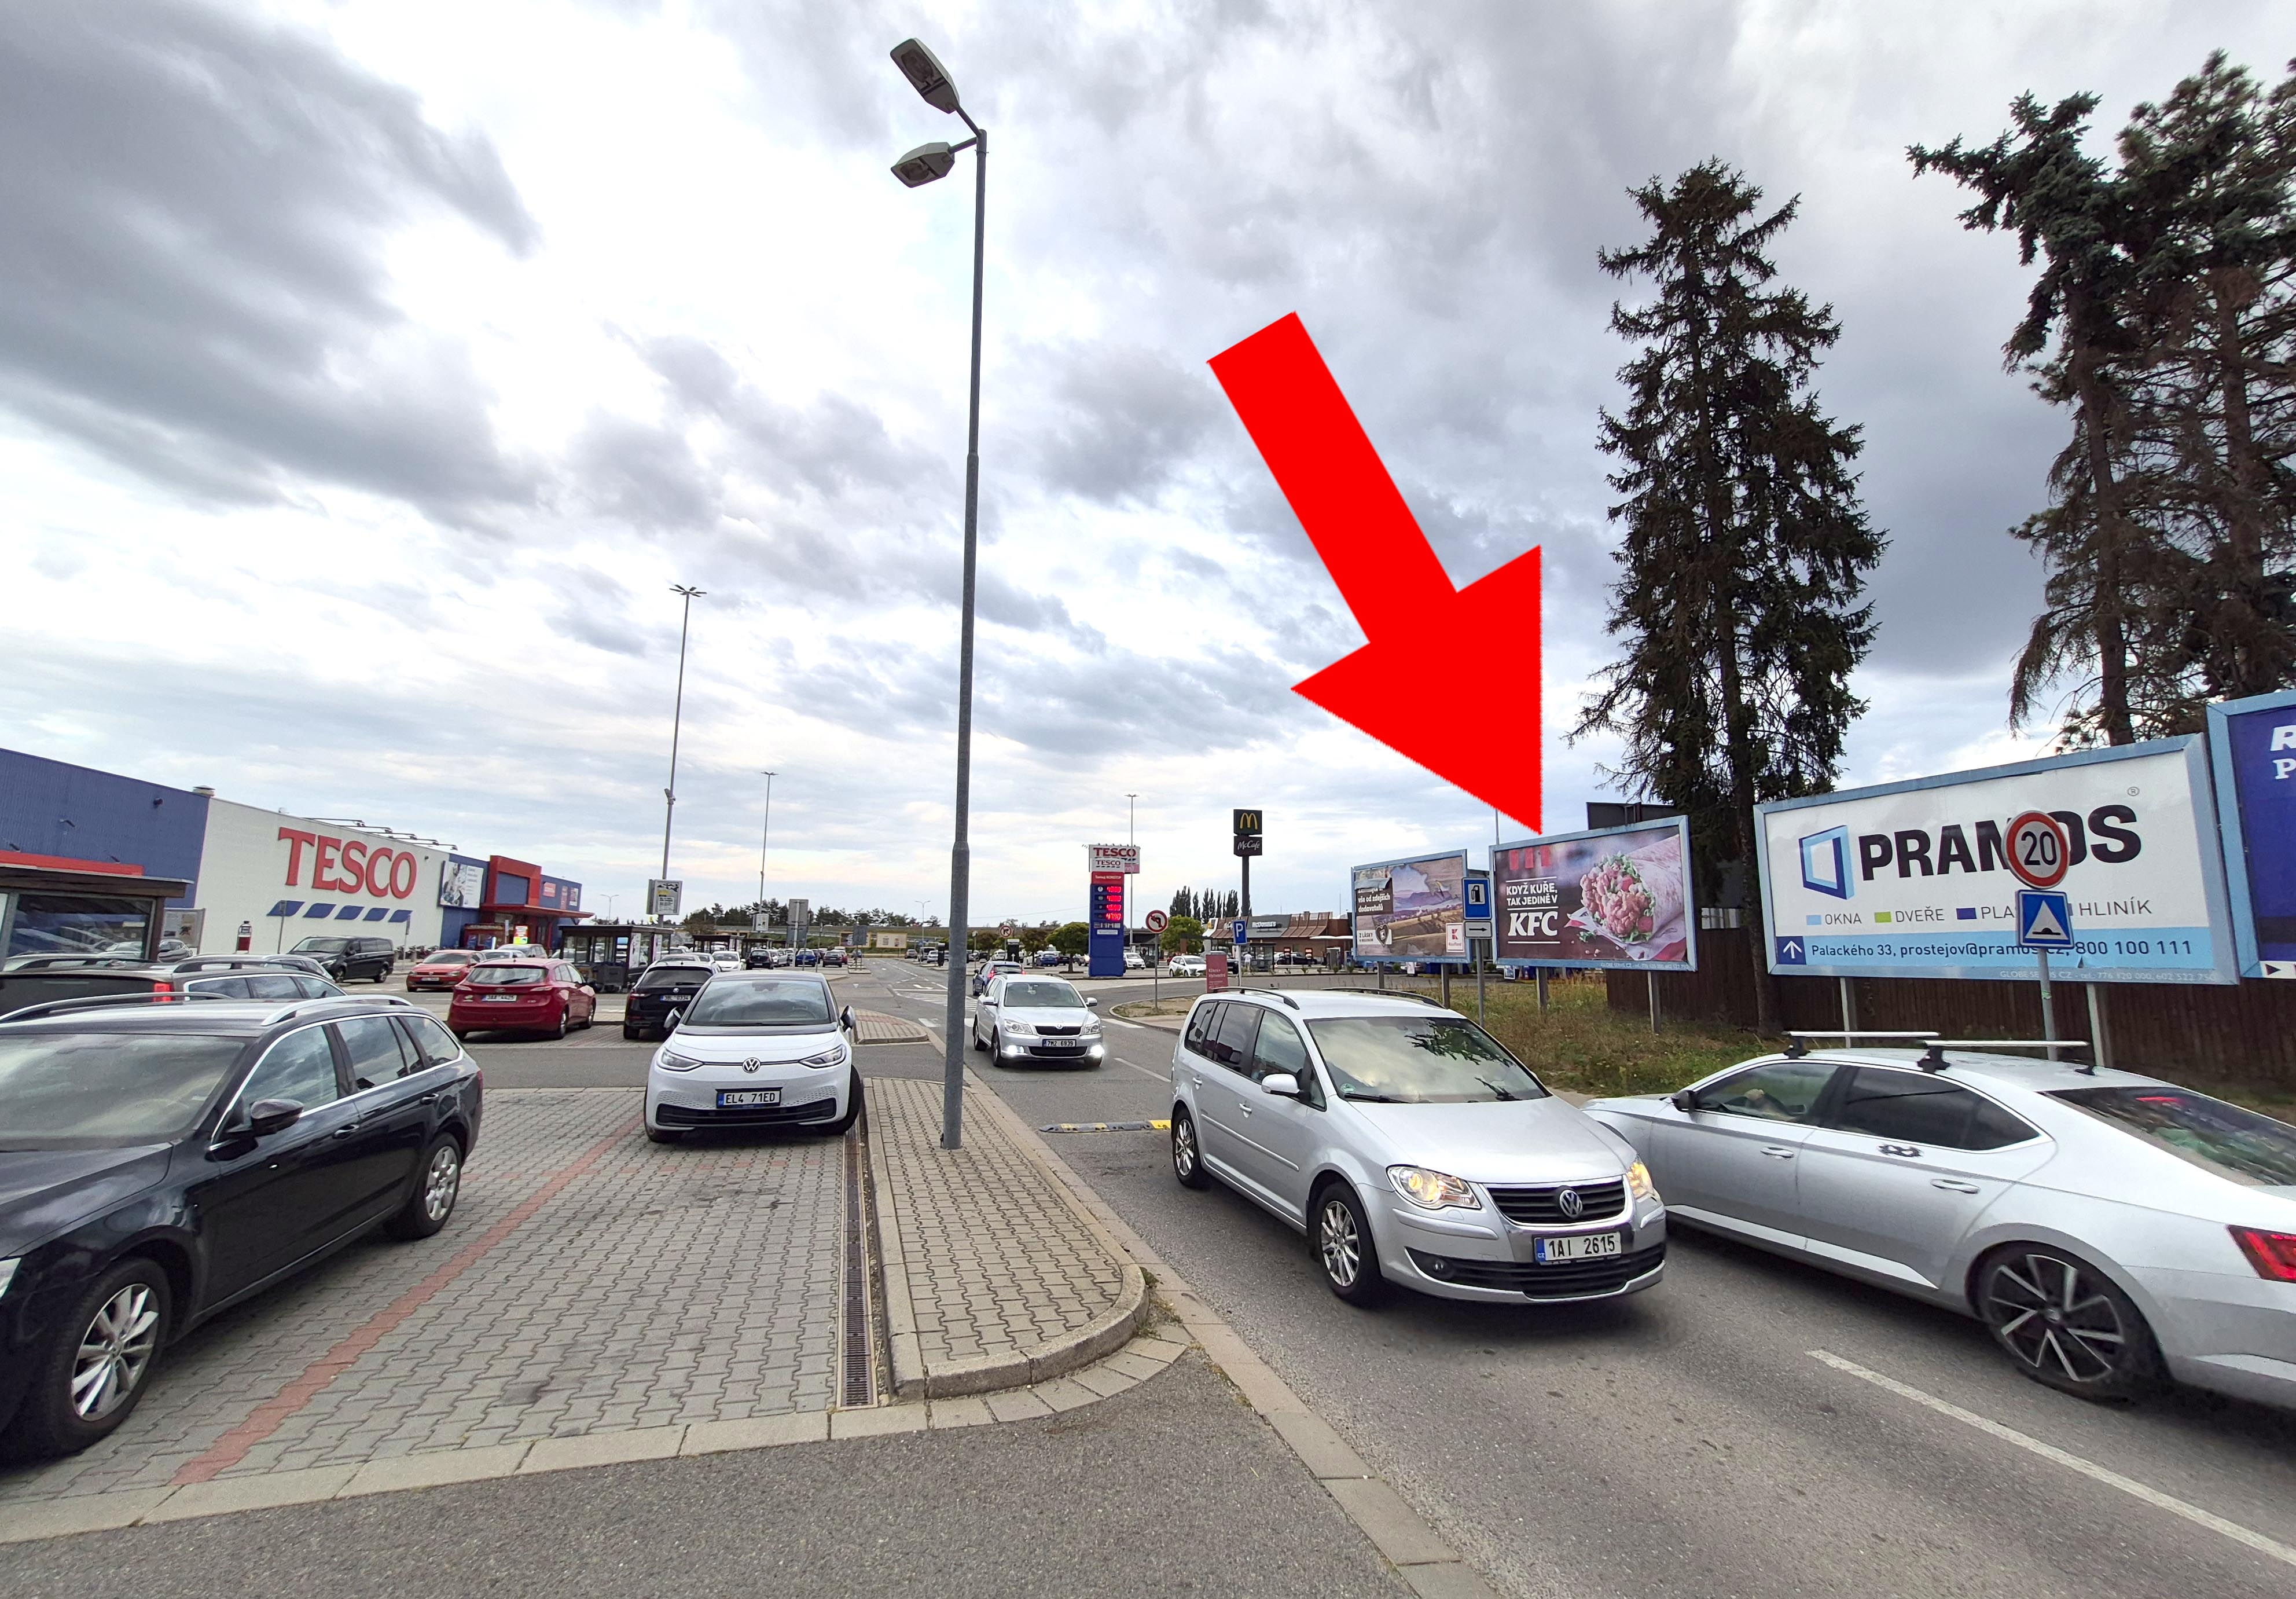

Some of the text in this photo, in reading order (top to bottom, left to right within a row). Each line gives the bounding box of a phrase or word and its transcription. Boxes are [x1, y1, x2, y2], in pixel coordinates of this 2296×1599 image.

[1093, 848, 1136, 857] TESCO
[2021, 830, 2058, 865] 20
[278, 827, 417, 899] TESCO
[1507, 881, 1557, 896] KDYŽ KUŘE,
[1507, 893, 1557, 906] TAK JEDINĚ V
[1825, 896, 2152, 925] OKNA DVEŘE PLA HLINÍK
[1236, 923, 1243, 937] P
[1508, 911, 1558, 936] KFC
[1812, 944, 1873, 956] Palackého
[1877, 944, 1896, 956] 33,
[2075, 941, 2108, 955] 800
[2115, 941, 2149, 955] 100
[2157, 940, 2191, 955] 111
[726, 1092, 775, 1103] EL4 71ED
[1549, 1235, 1615, 1257] 1AI 2615
